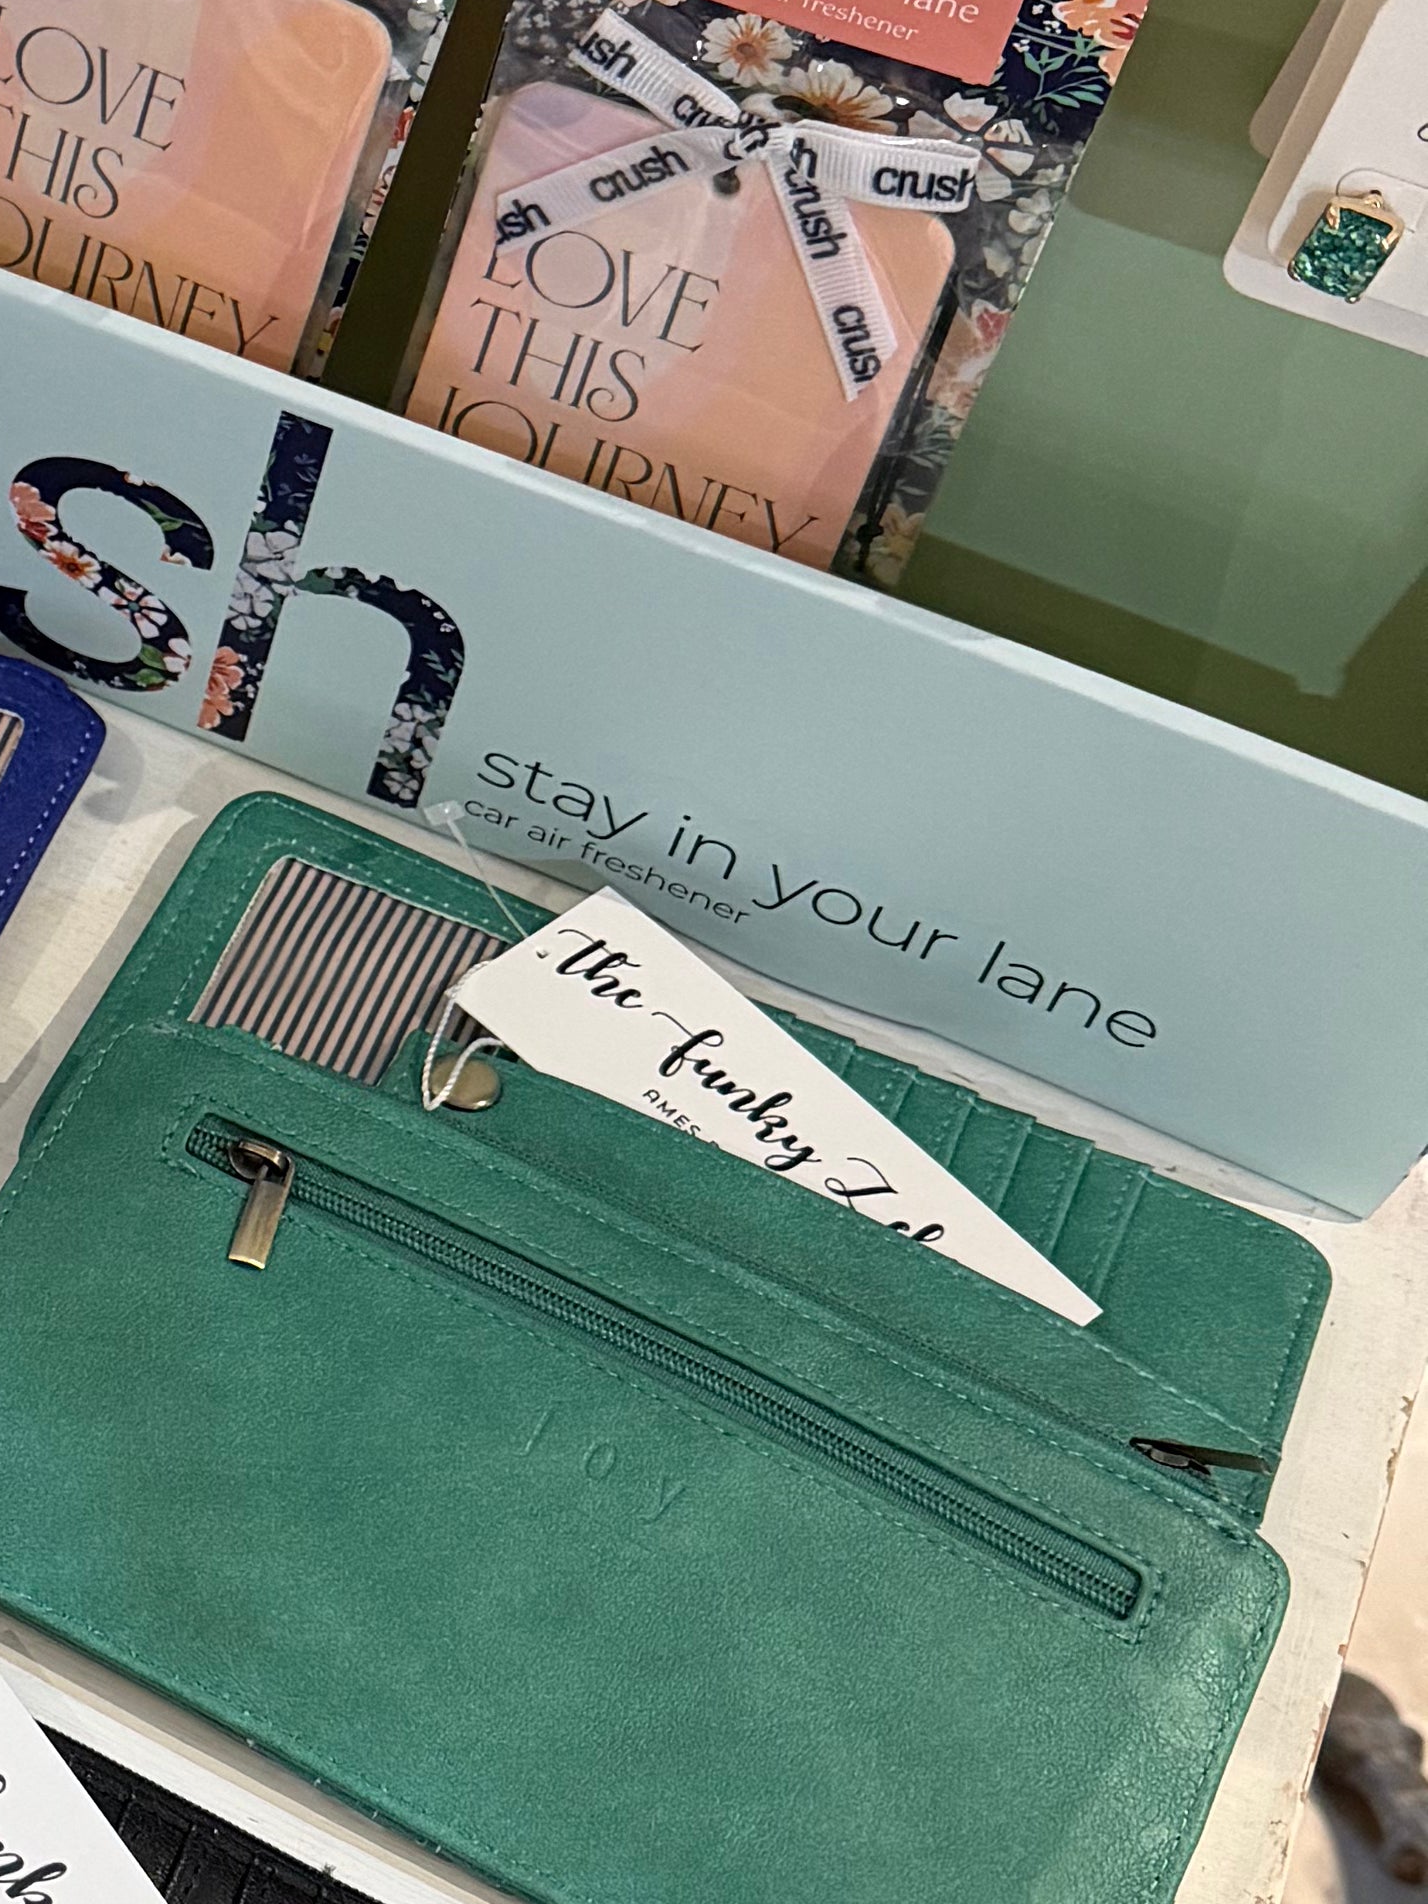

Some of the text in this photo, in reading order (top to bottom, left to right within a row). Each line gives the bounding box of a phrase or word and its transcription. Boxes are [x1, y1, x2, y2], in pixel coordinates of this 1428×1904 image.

[590, 146, 691, 203] crush
[785, 166, 847, 260] crush
[469, 298, 646, 422] THIS
[463, 797, 751, 924] car air freshener
[475, 748, 1157, 1048] stay in your lane
[557, 928, 822, 1172] the funky
[642, 1089, 702, 1137] AMES
